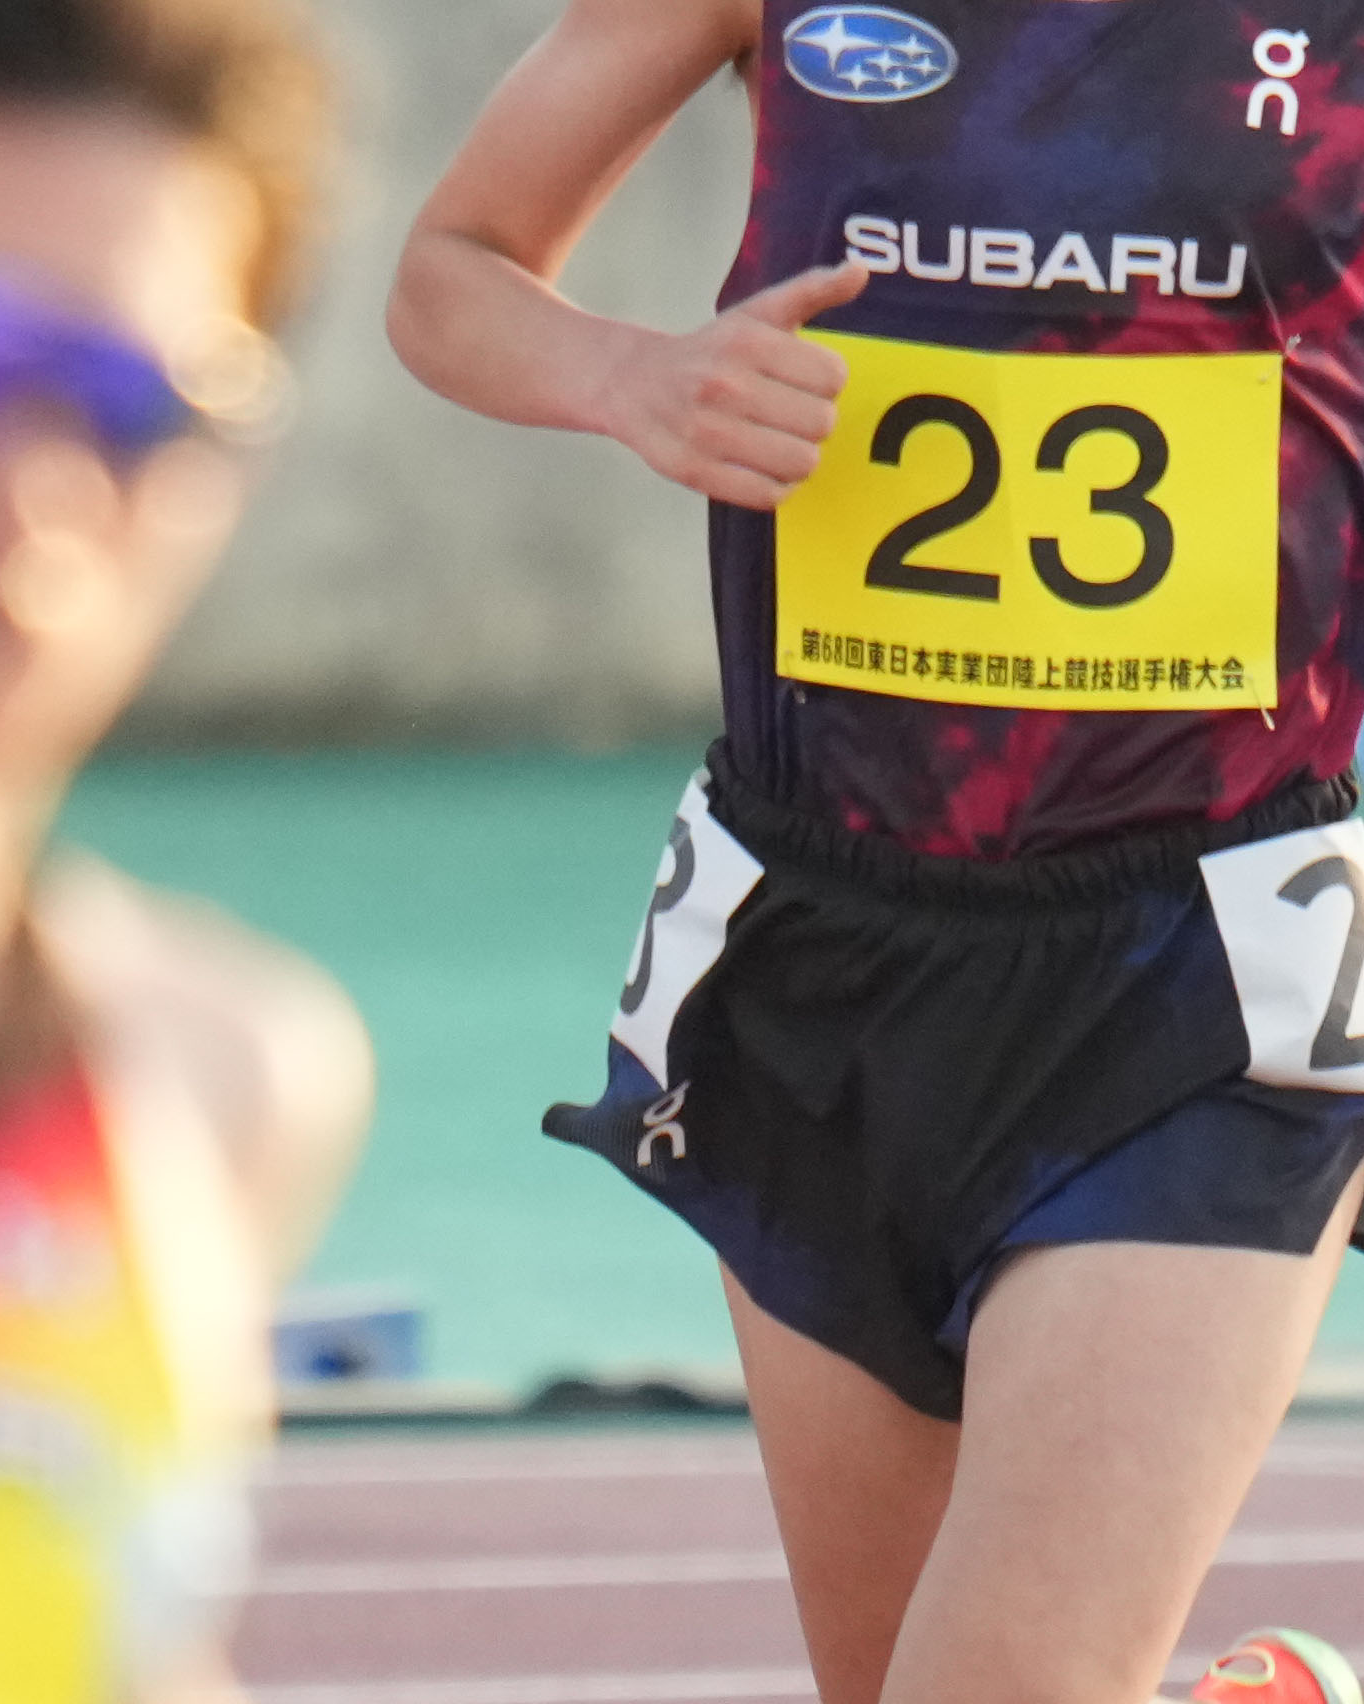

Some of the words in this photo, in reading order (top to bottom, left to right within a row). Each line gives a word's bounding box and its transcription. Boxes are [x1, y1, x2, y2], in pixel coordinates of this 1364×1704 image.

[843, 214, 1248, 299] SUBARU
[863, 392, 1176, 611] 23
[800, 627, 1246, 692] 第68回東日本実業団陸上競技選手権大会
